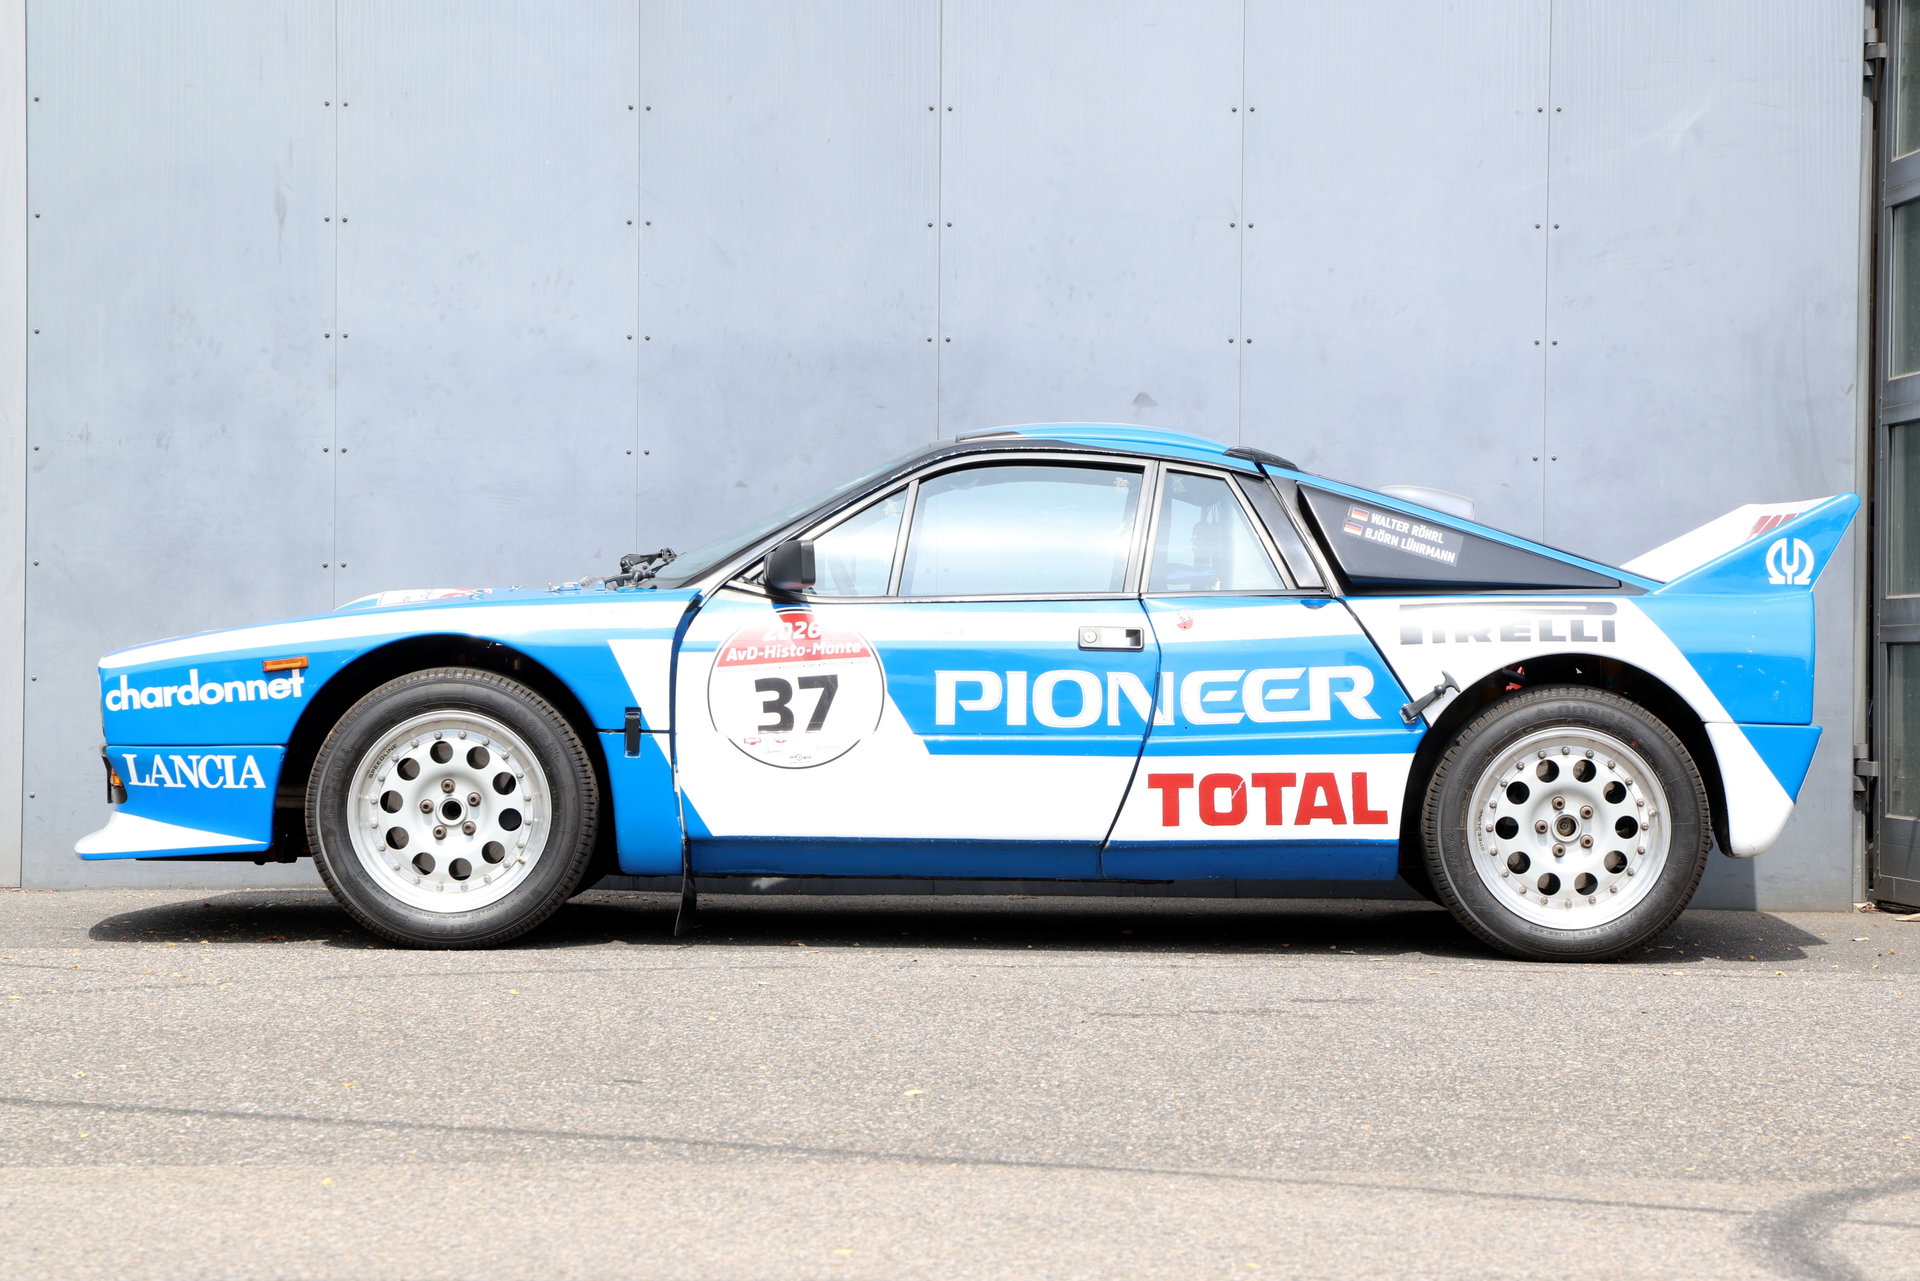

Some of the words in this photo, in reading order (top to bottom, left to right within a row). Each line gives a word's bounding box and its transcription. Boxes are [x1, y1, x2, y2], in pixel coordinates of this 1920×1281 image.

[1364, 527, 1400, 547] BJÖRN
[1400, 537, 1456, 564] LÜHRMANN
[1370, 512, 1410, 534] WALTER
[1411, 525, 1444, 545] RÖHRL
[725, 642, 863, 662] AvD-Histo-Monte
[105, 668, 305, 712] chardonnet
[754, 674, 839, 733] 37
[934, 665, 1382, 728] PIONEER
[121, 752, 266, 790] LANCIA
[369, 743, 398, 779] SPEEDLINE
[1147, 772, 1389, 827] TOTAL
